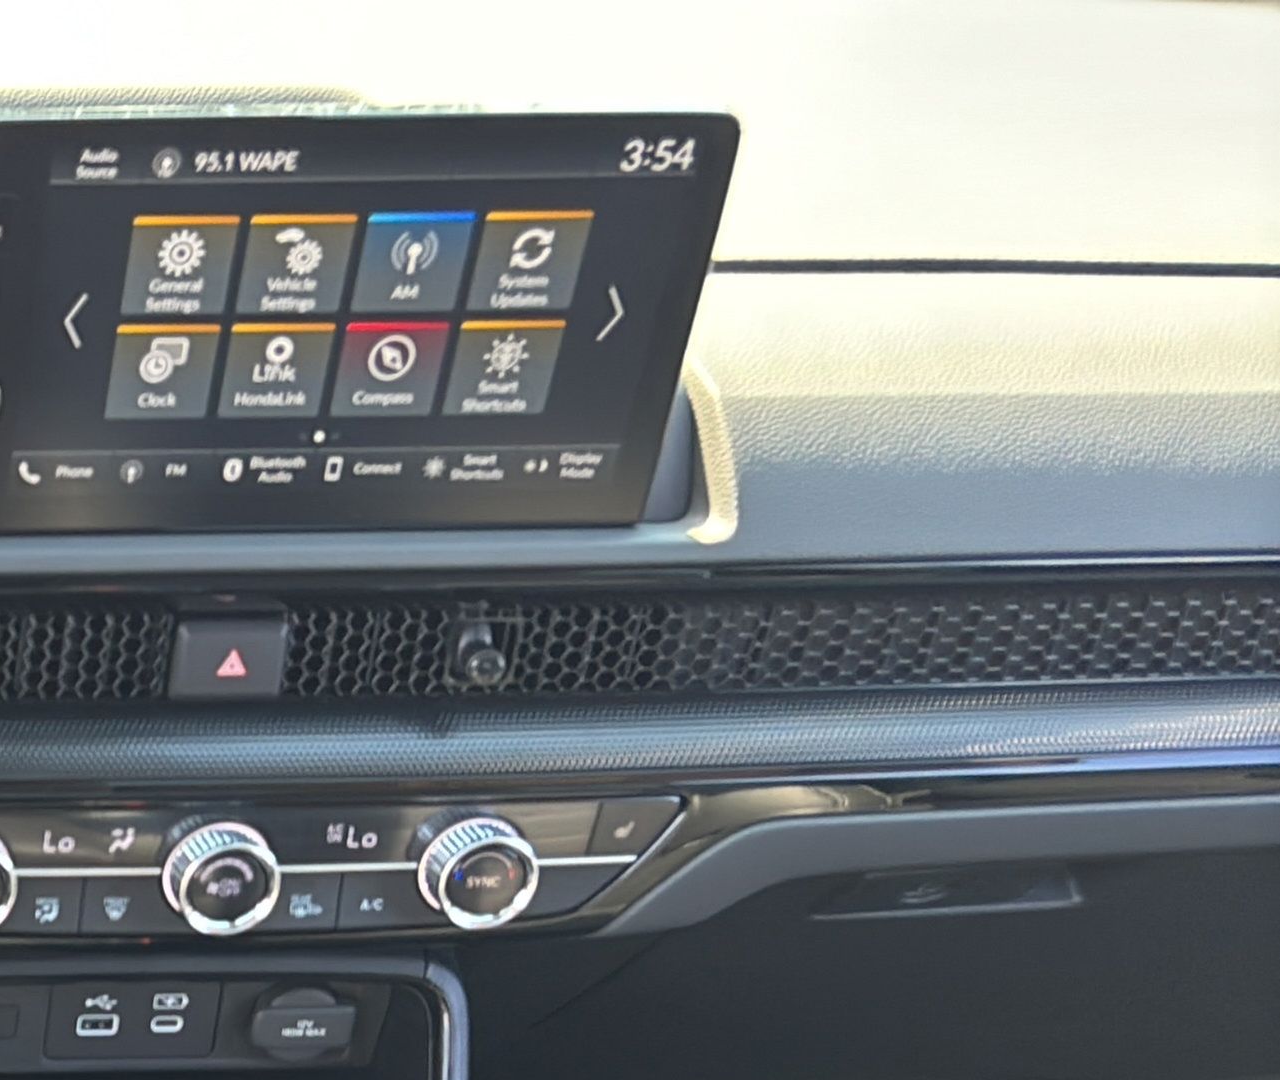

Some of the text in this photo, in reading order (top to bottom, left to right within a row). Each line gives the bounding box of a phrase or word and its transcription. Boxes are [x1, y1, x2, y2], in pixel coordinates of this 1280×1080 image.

[80, 148, 119, 164] Audio
[195, 150, 300, 172] 95.1 WAPE
[620, 138, 696, 173] 3:54
[75, 166, 119, 179] Source
[148, 278, 204, 293] General
[267, 277, 318, 293] Vehicle
[498, 274, 550, 290] System
[391, 285, 420, 300] AM
[145, 296, 202, 314] Settings
[260, 295, 317, 313] Settings
[490, 293, 549, 310] Updates
[478, 381, 520, 395] Smart
[137, 392, 177, 408] Clock
[234, 392, 306, 408] HondaLink
[351, 391, 415, 408] Compass
[461, 398, 528, 413] Shortcuts
[250, 455, 307, 470] Bluetooth
[463, 453, 497, 466] Smart
[559, 452, 603, 466] Display
[55, 465, 94, 479] Phone
[165, 463, 187, 477] FM
[353, 461, 403, 476] Connect
[257, 470, 293, 484] Audio
[42, 829, 76, 854] Lo
[346, 825, 379, 849] Lo
[465, 876, 500, 889] SYNC
[359, 899, 384, 912] A/C
